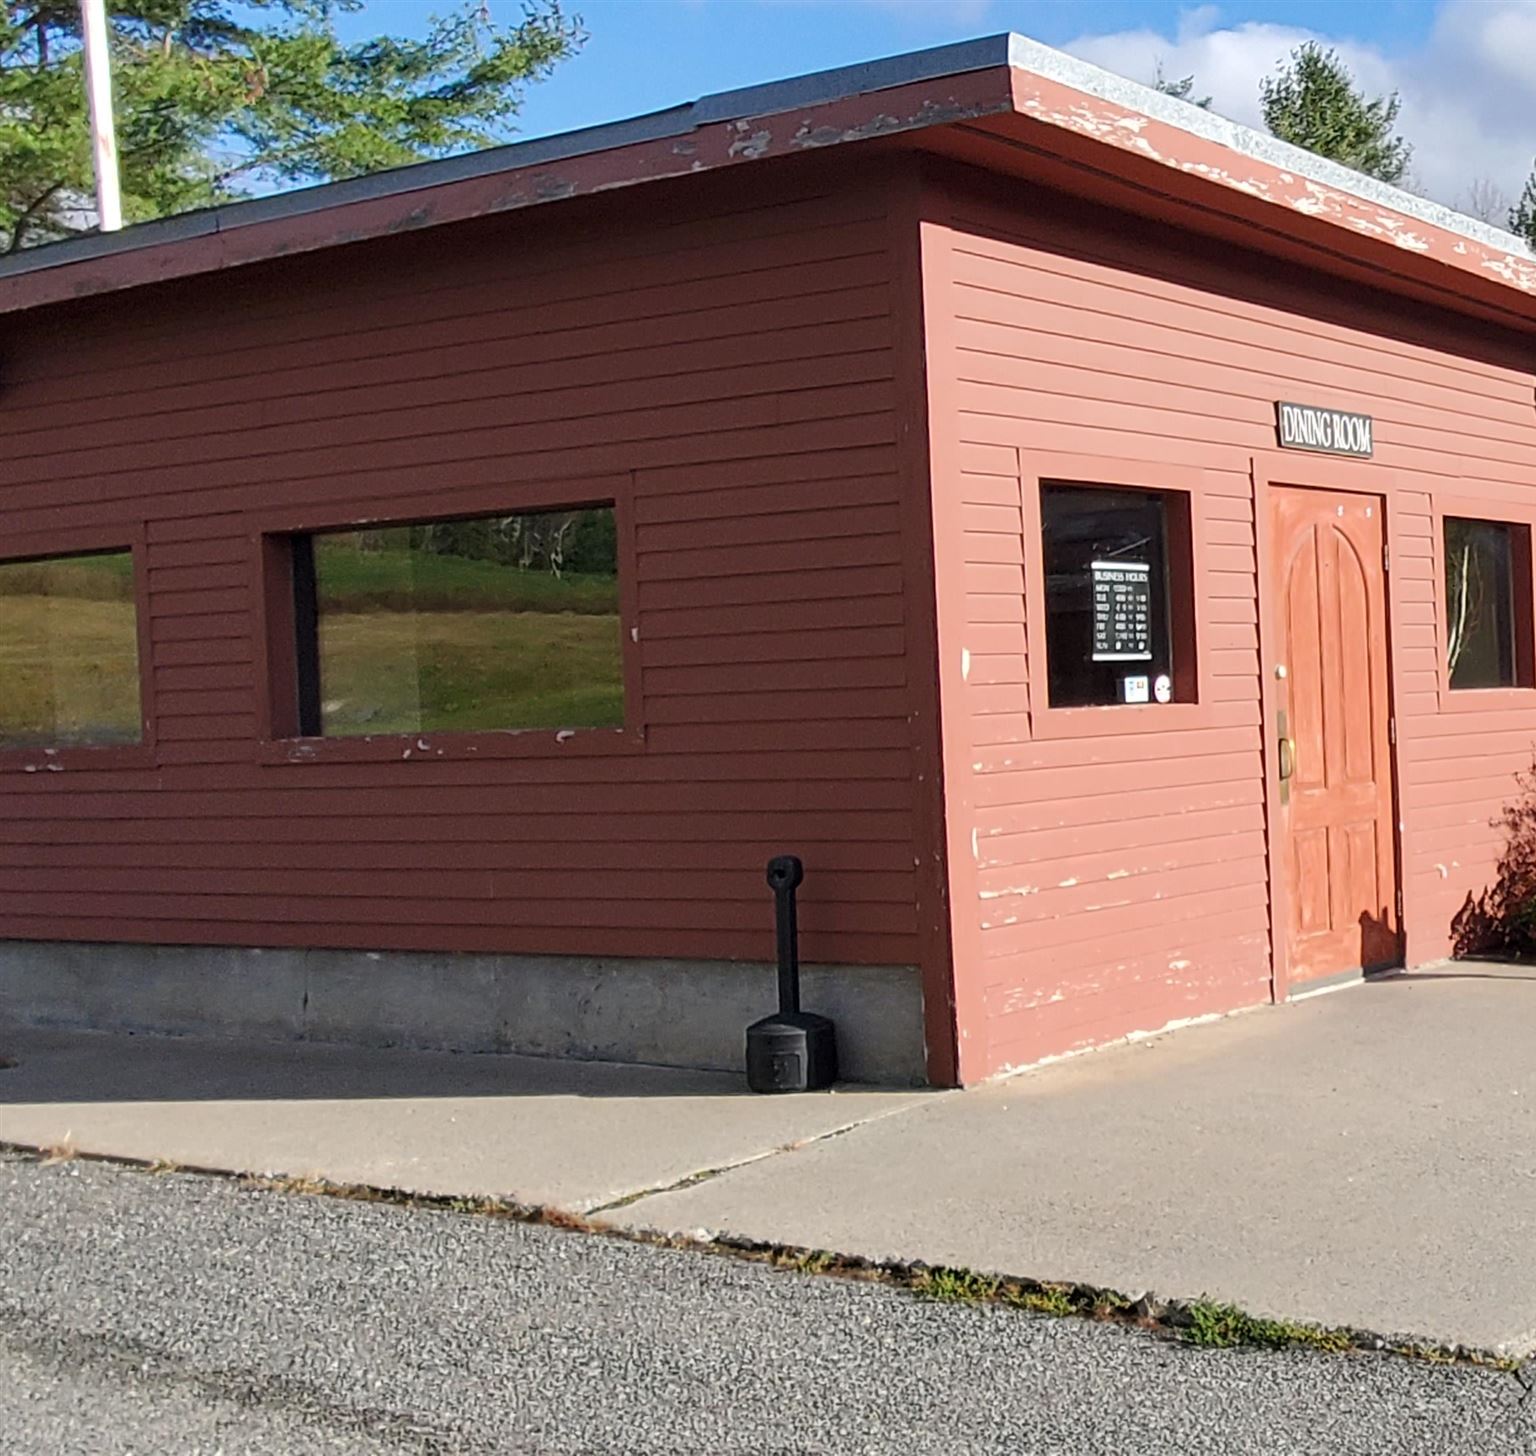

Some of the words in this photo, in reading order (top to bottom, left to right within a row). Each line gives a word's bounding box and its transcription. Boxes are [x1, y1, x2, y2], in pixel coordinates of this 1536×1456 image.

[1282, 406, 1331, 447] DINING
[1332, 414, 1372, 453] ROOM
[1094, 571, 1124, 582] BUSINESS
[1125, 572, 1148, 582] HOURS
